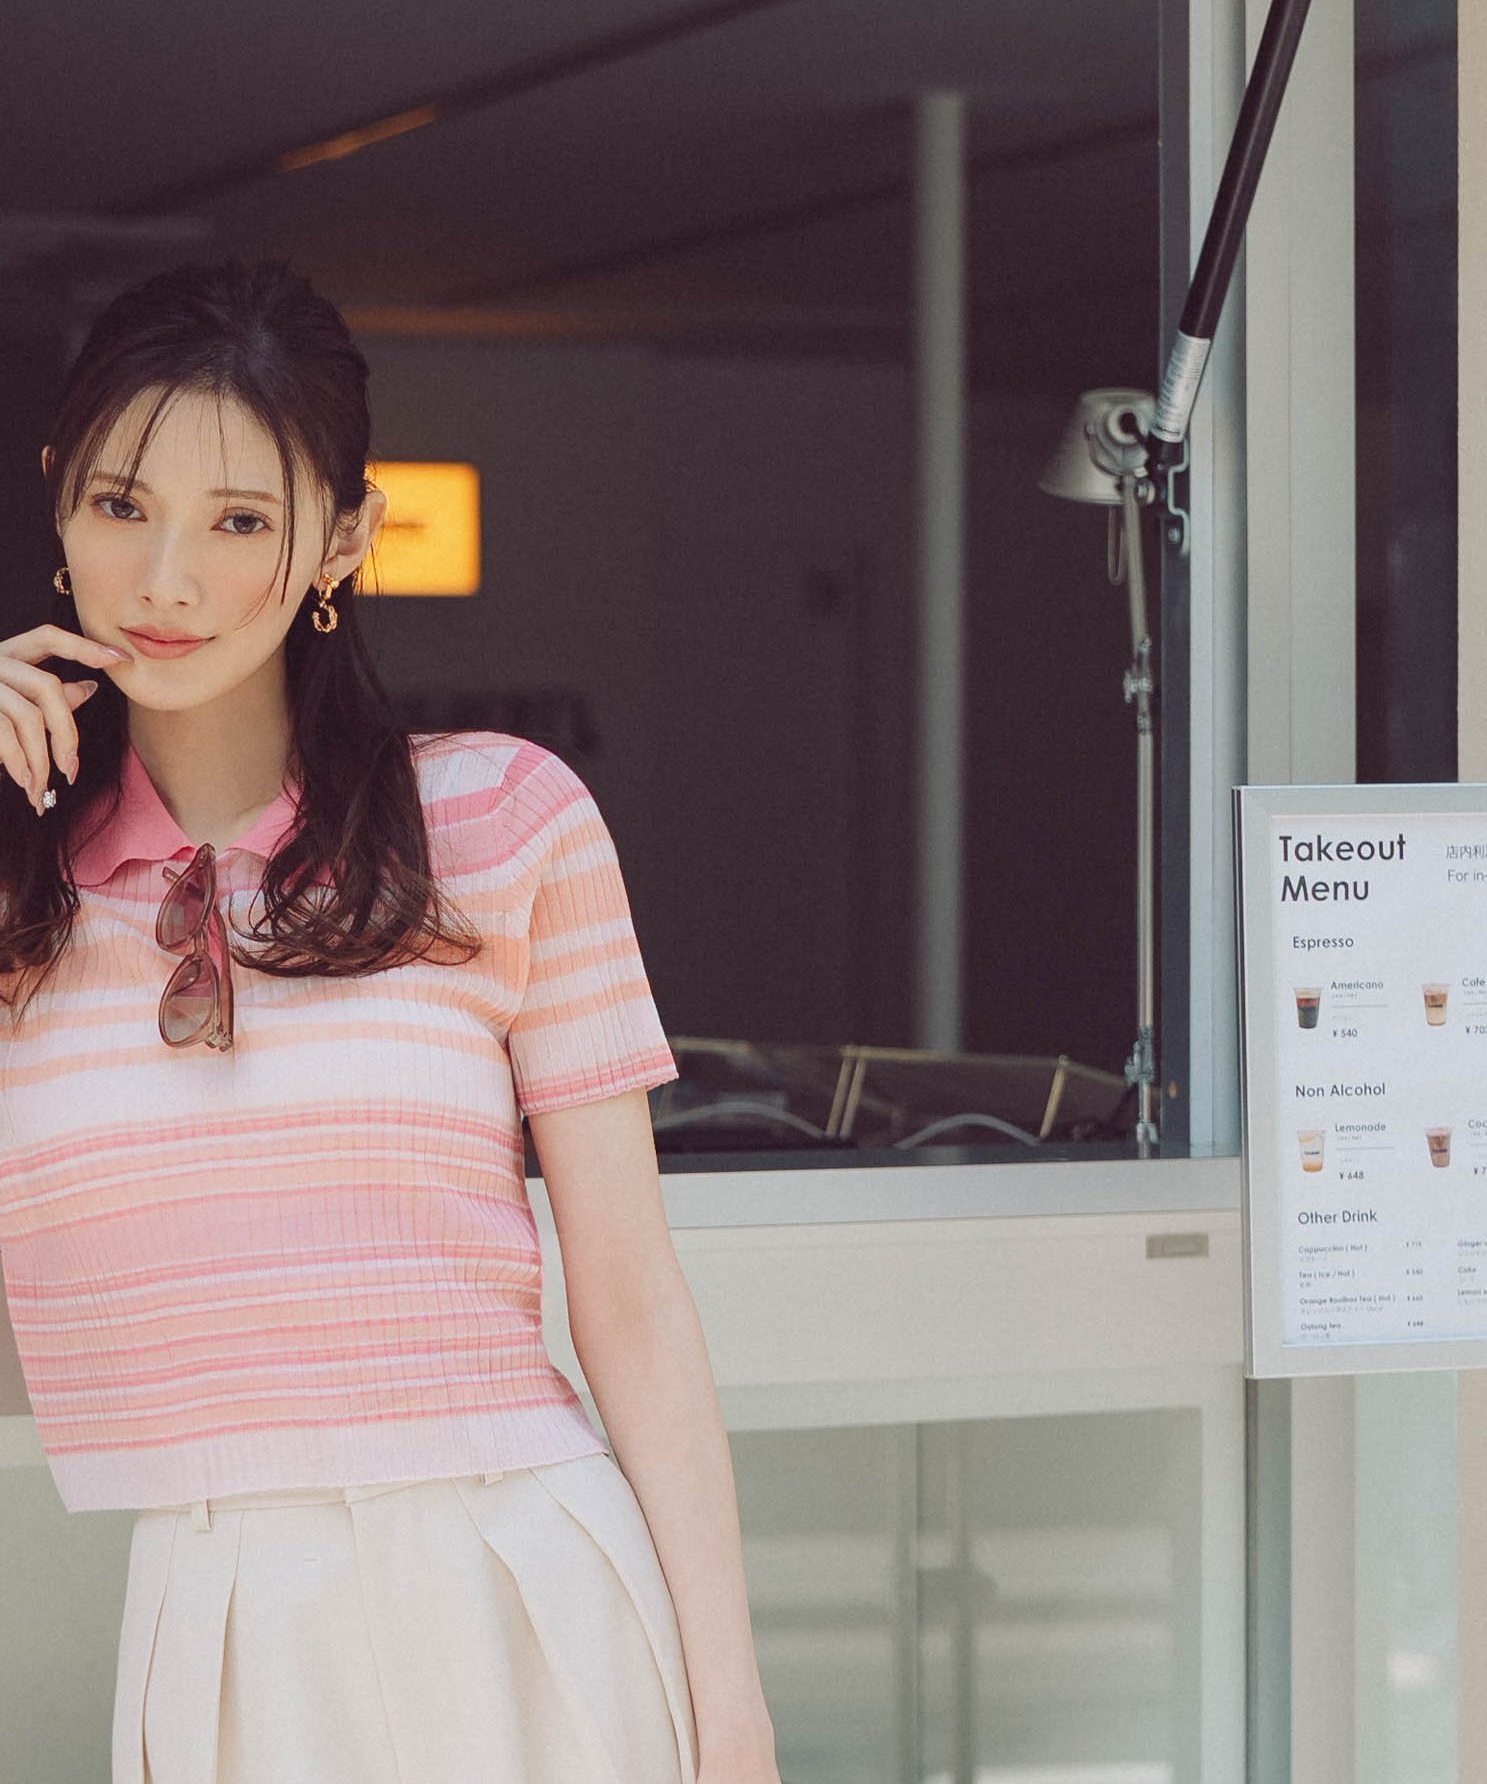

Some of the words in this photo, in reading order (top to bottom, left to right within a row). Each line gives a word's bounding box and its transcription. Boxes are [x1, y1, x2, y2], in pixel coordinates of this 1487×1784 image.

[1279, 833, 1406, 862] Takeout
[1446, 844, 1487, 860] 店内利
[1448, 869, 1470, 882] For
[1281, 875, 1369, 902] Menu
[1293, 935, 1354, 951] Espresso
[1330, 980, 1384, 990] Americano
[1295, 1083, 1325, 1098] Non
[1330, 1082, 1386, 1097] Alcohol
[1334, 1122, 1387, 1133] Lemonade
[1297, 1210, 1338, 1226] Other
[1342, 1209, 1378, 1224] Drink
